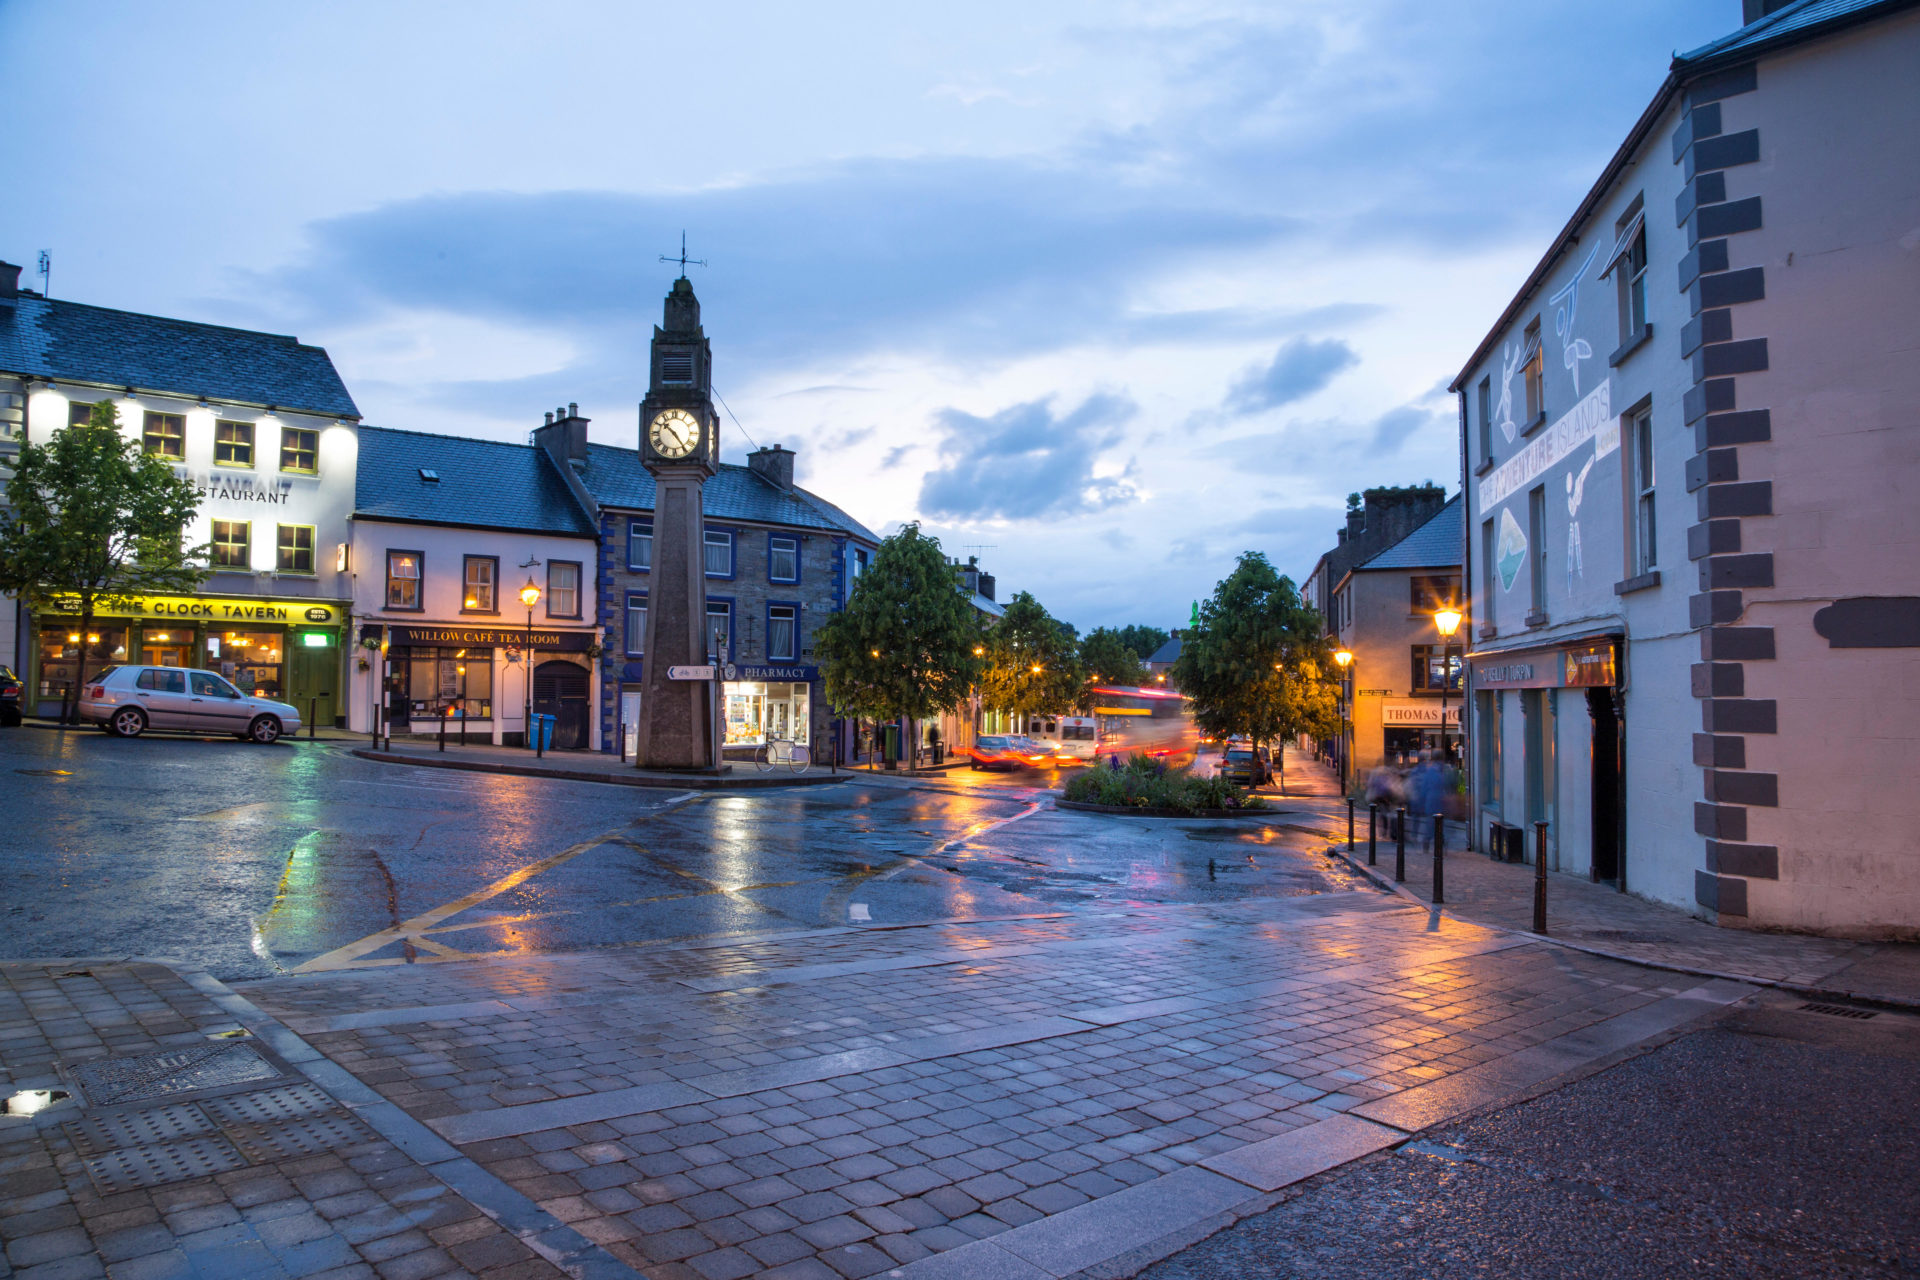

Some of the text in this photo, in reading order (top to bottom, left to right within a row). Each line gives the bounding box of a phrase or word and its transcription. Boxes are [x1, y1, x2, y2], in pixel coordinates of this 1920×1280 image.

[1556, 386, 1609, 454] ISLANDS
[182, 485, 289, 505] STAURANT
[154, 603, 213, 616] CLOCK
[222, 605, 287, 619] TAVERN
[408, 630, 560, 645] WILLOW CAFÉ TEA ROOM
[744, 668, 806, 678] PHARMACY
[1387, 709, 1438, 720] THOMAS
